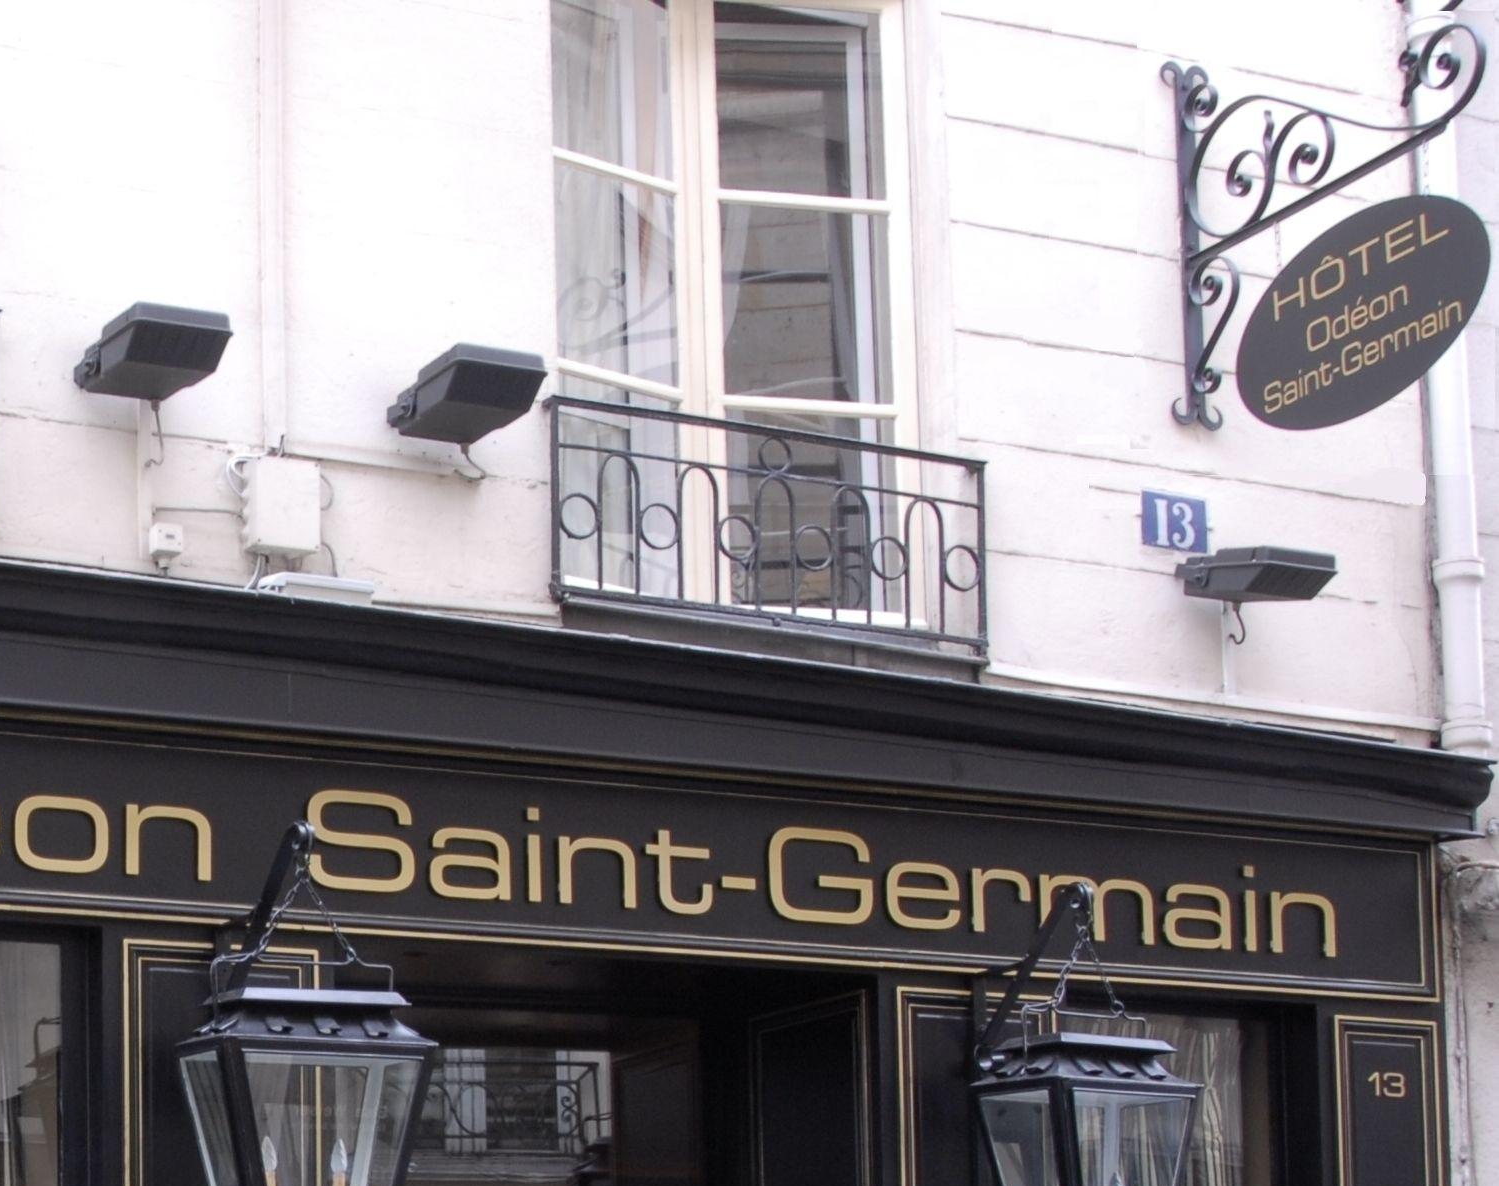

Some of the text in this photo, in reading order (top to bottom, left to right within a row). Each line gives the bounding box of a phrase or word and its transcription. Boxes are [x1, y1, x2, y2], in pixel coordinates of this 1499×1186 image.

[1272, 213, 1449, 322] HÔTEL
[1263, 300, 1462, 414] Saint-Germain
[1306, 285, 1408, 352] Odéon
[1154, 498, 1195, 550] 13
[307, 789, 1337, 958] Saint-Germain
[1367, 1071, 1406, 1098] 13
